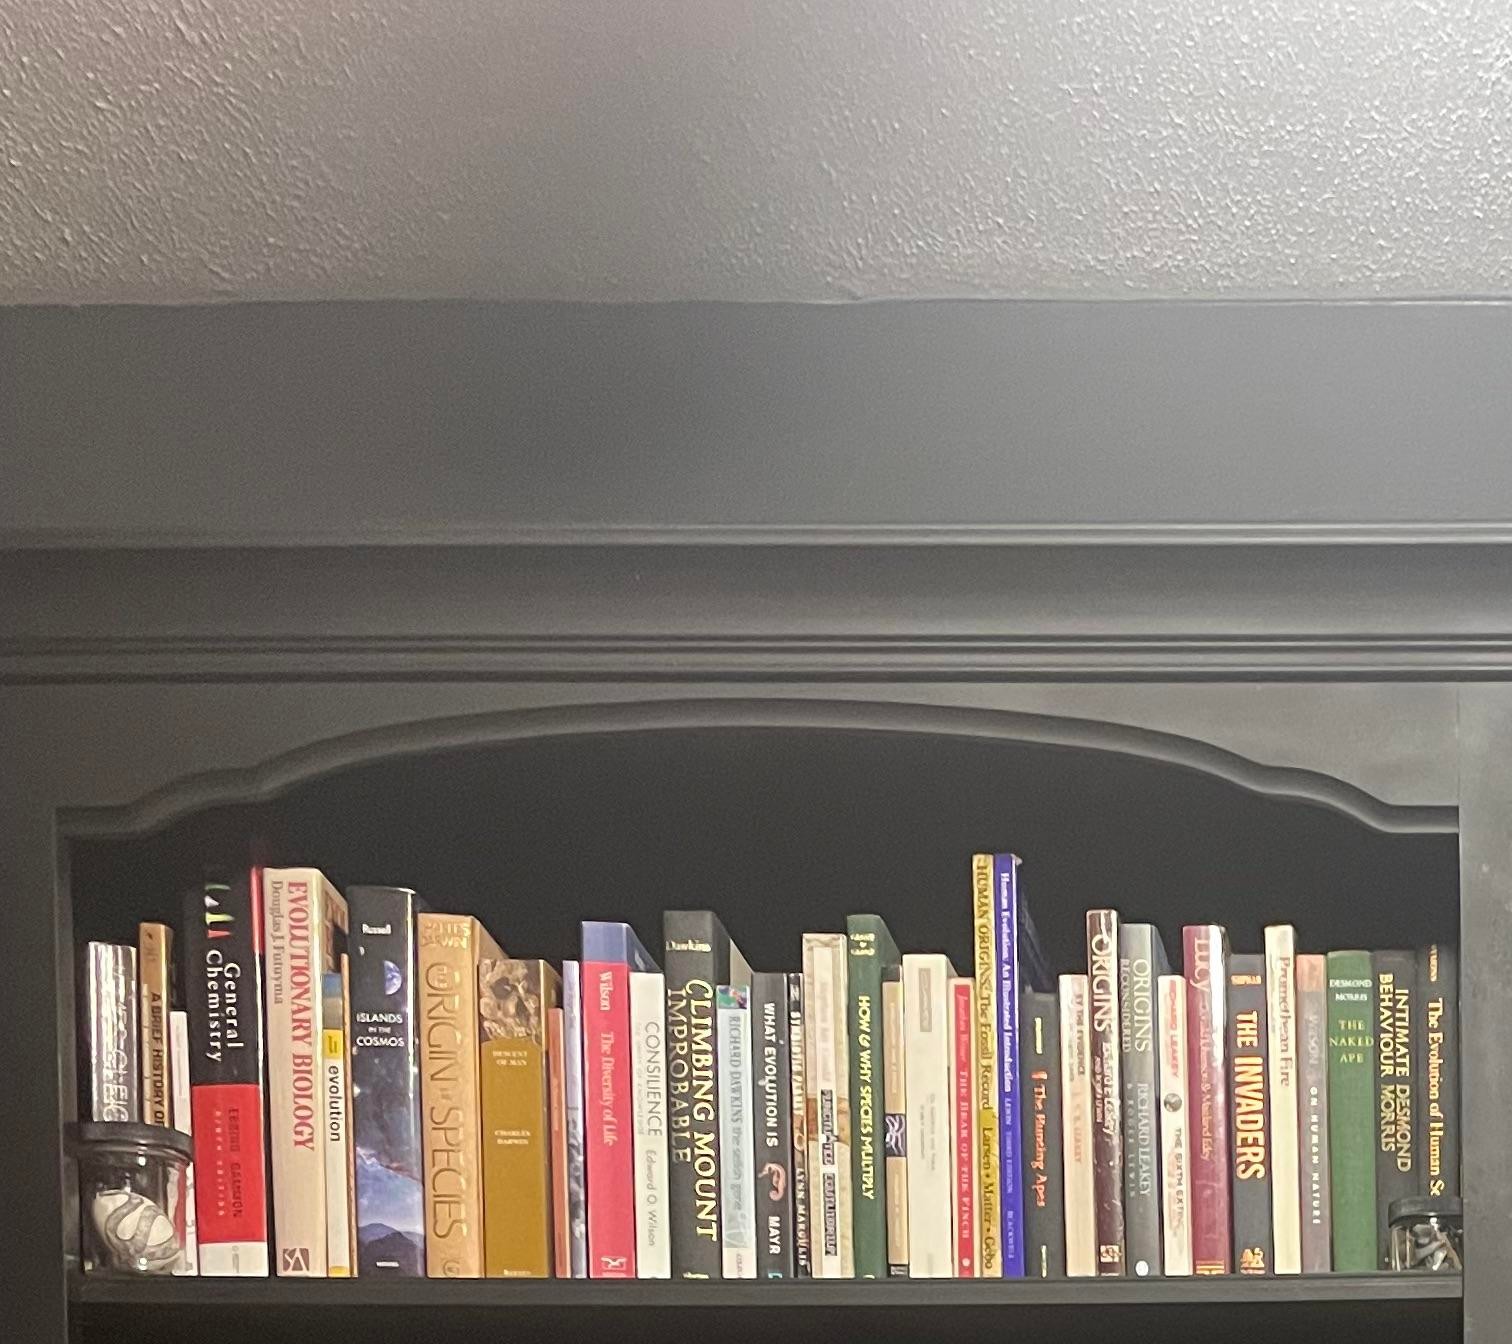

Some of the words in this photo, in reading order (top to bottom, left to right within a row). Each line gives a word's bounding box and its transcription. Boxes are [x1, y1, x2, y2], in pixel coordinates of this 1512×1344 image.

[206, 950, 224, 1062] Chemistry
[225, 963, 242, 1048] General
[288, 881, 311, 1048] EVOLUTIONARY
[427, 963, 459, 1081] ORIGIN
[687, 979, 715, 1121] CLIMBING
[764, 1003, 776, 1041] WHAT
[1237, 1012, 1258, 1047] THE
[1380, 974, 1393, 1076] BEHAVIOUR
[1396, 989, 1409, 1076] INTIMATE
[292, 1054, 314, 1150] BIOLOGY
[328, 1066, 343, 1142] evolution
[668, 988, 690, 1162] IMPROBABLE
[764, 1047, 777, 1127] EVOLUTION
[1234, 1057, 1264, 1179] INVADERS
[431, 1107, 466, 1239] SPECIES
[693, 1131, 717, 1241] MOUNT
[766, 1132, 778, 1146] IS
